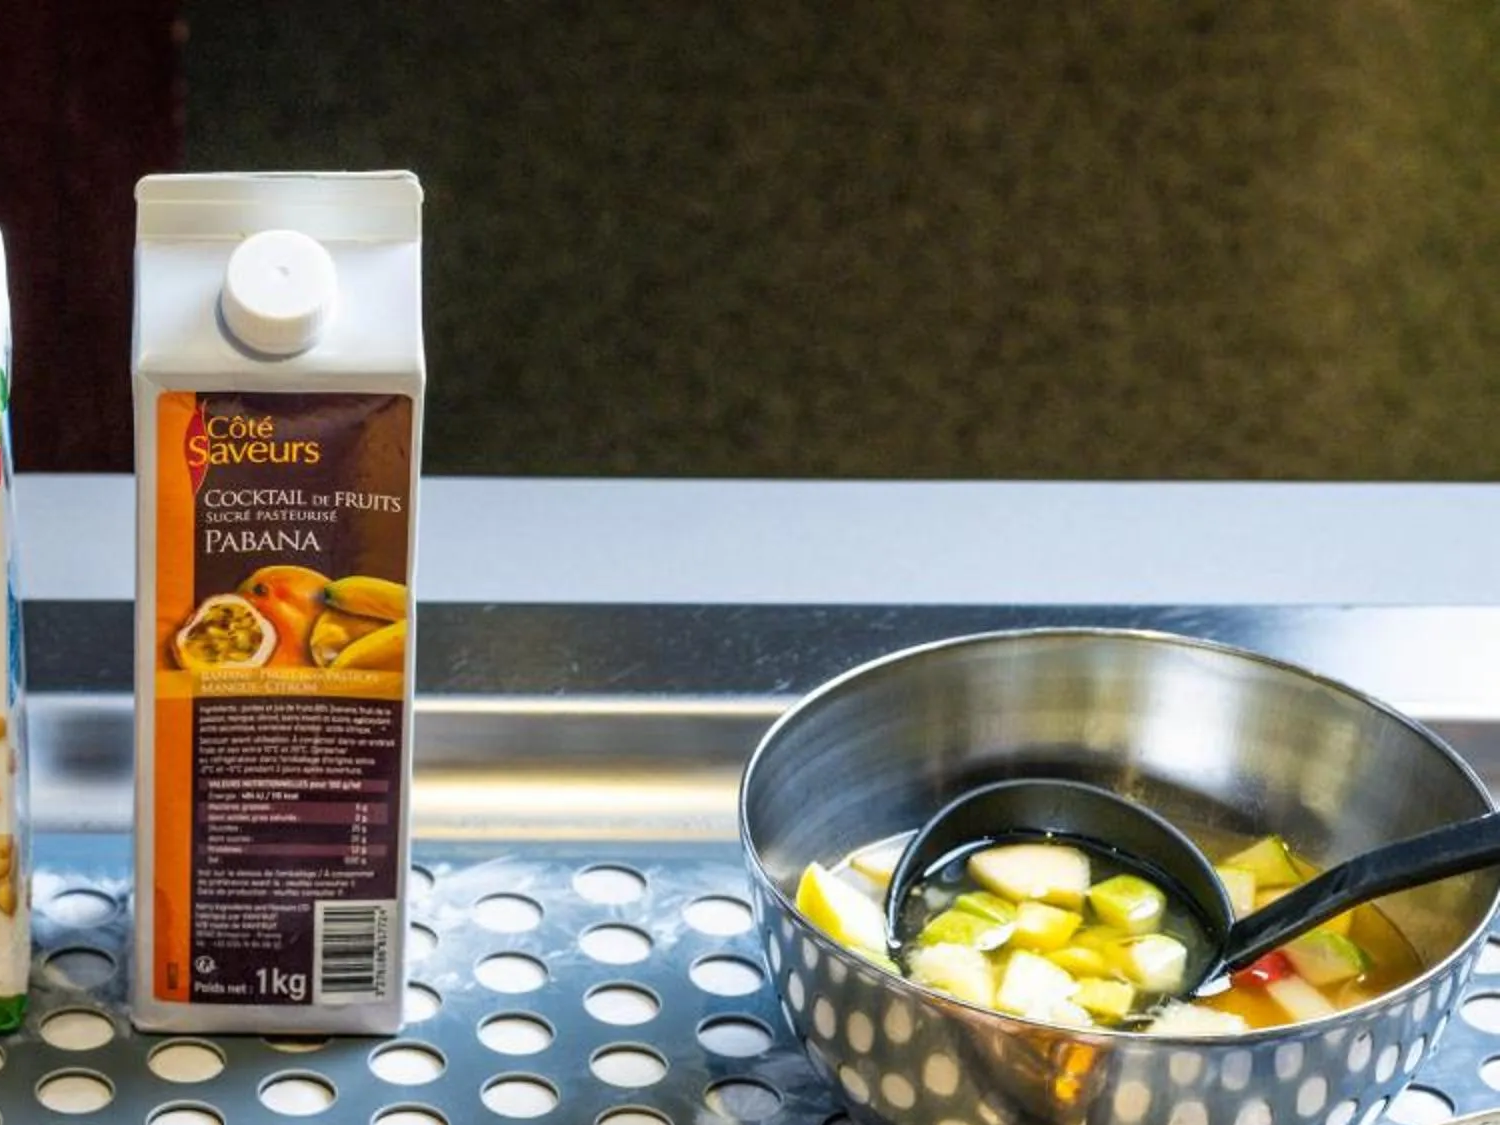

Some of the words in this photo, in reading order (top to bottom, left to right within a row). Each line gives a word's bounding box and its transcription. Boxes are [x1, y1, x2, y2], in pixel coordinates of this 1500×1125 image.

[207, 415, 274, 439] Côté
[188, 435, 320, 466] Saveurs
[204, 489, 307, 508] COCKTAIL
[312, 494, 331, 506] DE
[334, 491, 402, 513] FRUITS
[205, 528, 321, 554] PABANA
